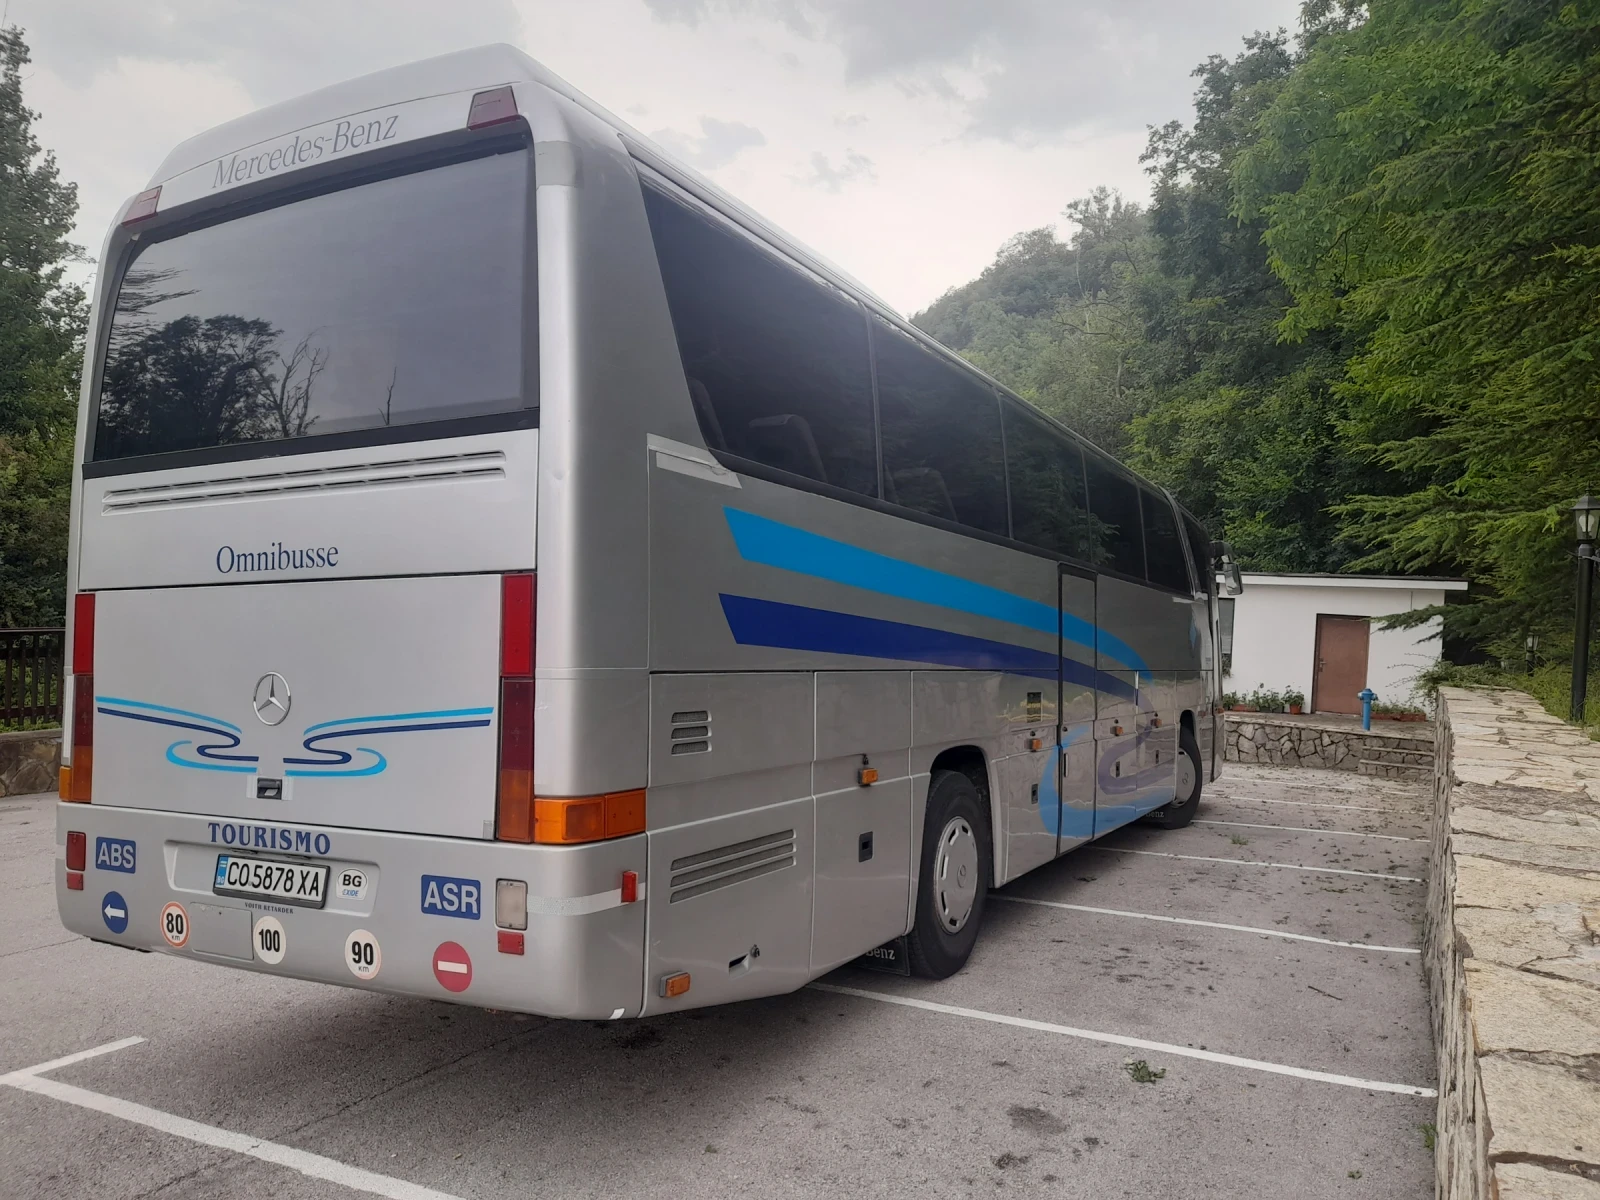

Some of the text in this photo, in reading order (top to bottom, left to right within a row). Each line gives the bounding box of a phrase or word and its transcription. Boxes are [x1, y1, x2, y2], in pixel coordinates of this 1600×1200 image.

[211, 115, 399, 189] Mercedes-Benz
[216, 542, 339, 573] Omnibusse
[208, 822, 331, 855] TOURISMO
[97, 842, 135, 869] ABS
[342, 874, 362, 888] BG
[342, 888, 360, 897] EXIDE
[244, 902, 294, 914] VOITH RETARDER
[423, 880, 479, 914] ASR
[166, 912, 184, 935] 80
[258, 928, 281, 953] 100
[351, 940, 374, 966] 90
